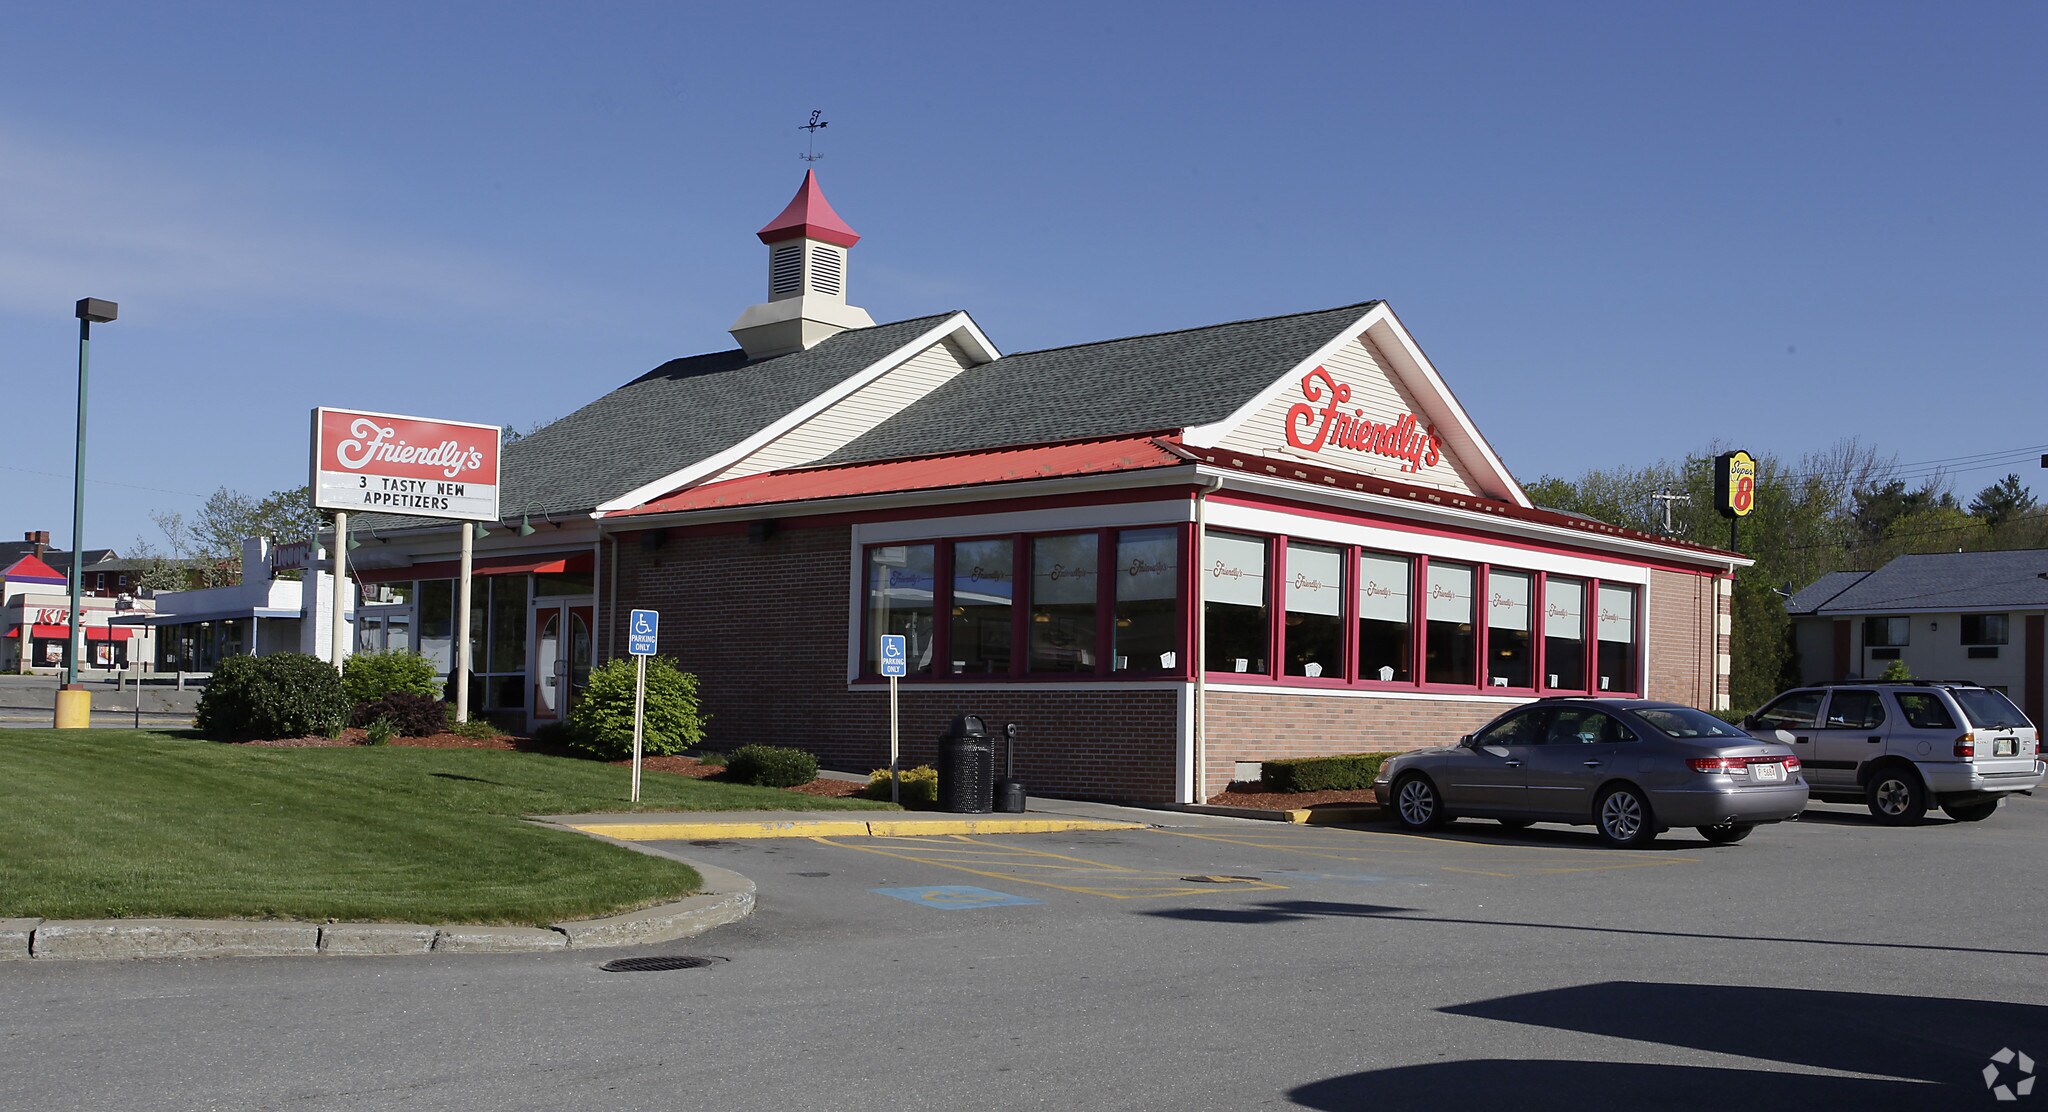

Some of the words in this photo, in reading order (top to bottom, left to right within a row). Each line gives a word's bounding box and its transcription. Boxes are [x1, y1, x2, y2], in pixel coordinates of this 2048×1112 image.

[1286, 365, 1442, 473] Friendly's
[337, 418, 483, 478] Friendly's
[1731, 460, 1753, 480] Super
[359, 476, 367, 488] 3
[382, 478, 426, 493] TASTY
[437, 483, 465, 496] NEW
[1734, 477, 1753, 511] 8
[364, 491, 449, 510] APPETIZERS
[1213, 560, 1243, 580] Friendly's
[1294, 573, 1322, 591] Friendly's
[1366, 581, 1391, 598] Friendly's
[631, 634, 656, 643] PARKING
[635, 643, 651, 652] ONLY
[882, 657, 905, 666] PARKING
[886, 665, 900, 673] ONLY
